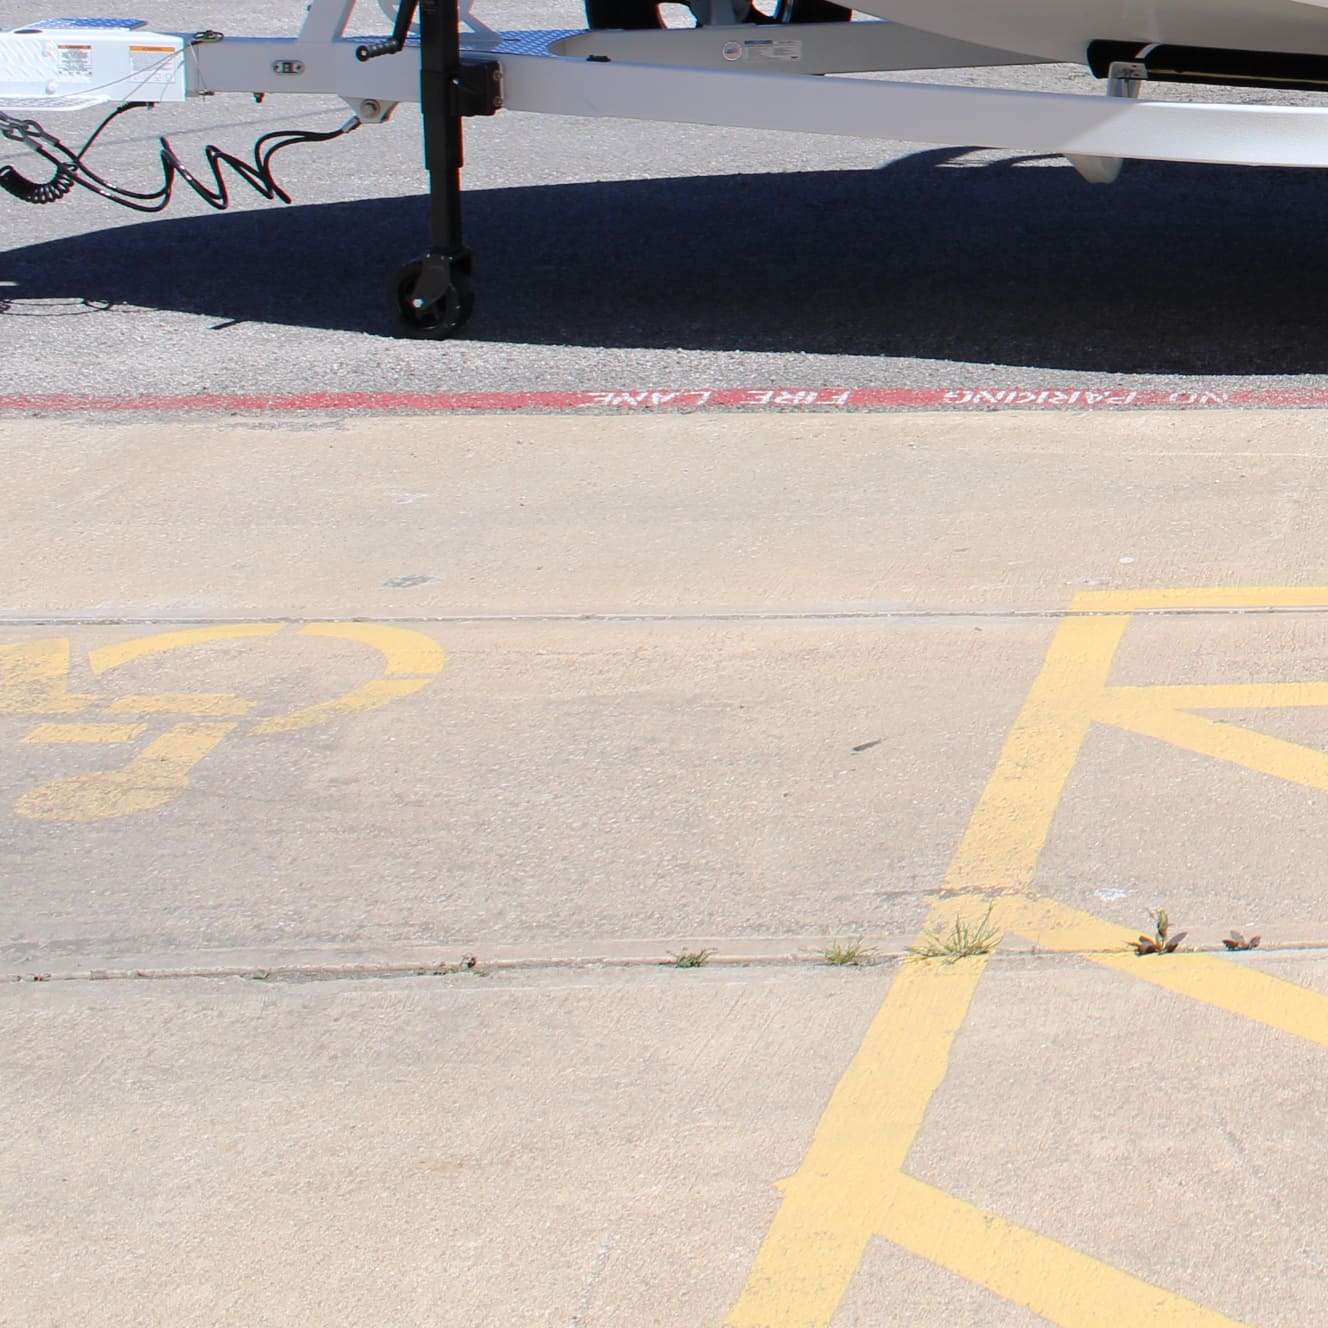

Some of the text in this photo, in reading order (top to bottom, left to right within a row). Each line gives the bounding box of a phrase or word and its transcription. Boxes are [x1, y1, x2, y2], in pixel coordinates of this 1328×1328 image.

[575, 389, 1229, 408] NO PARKING FIRE LANE
